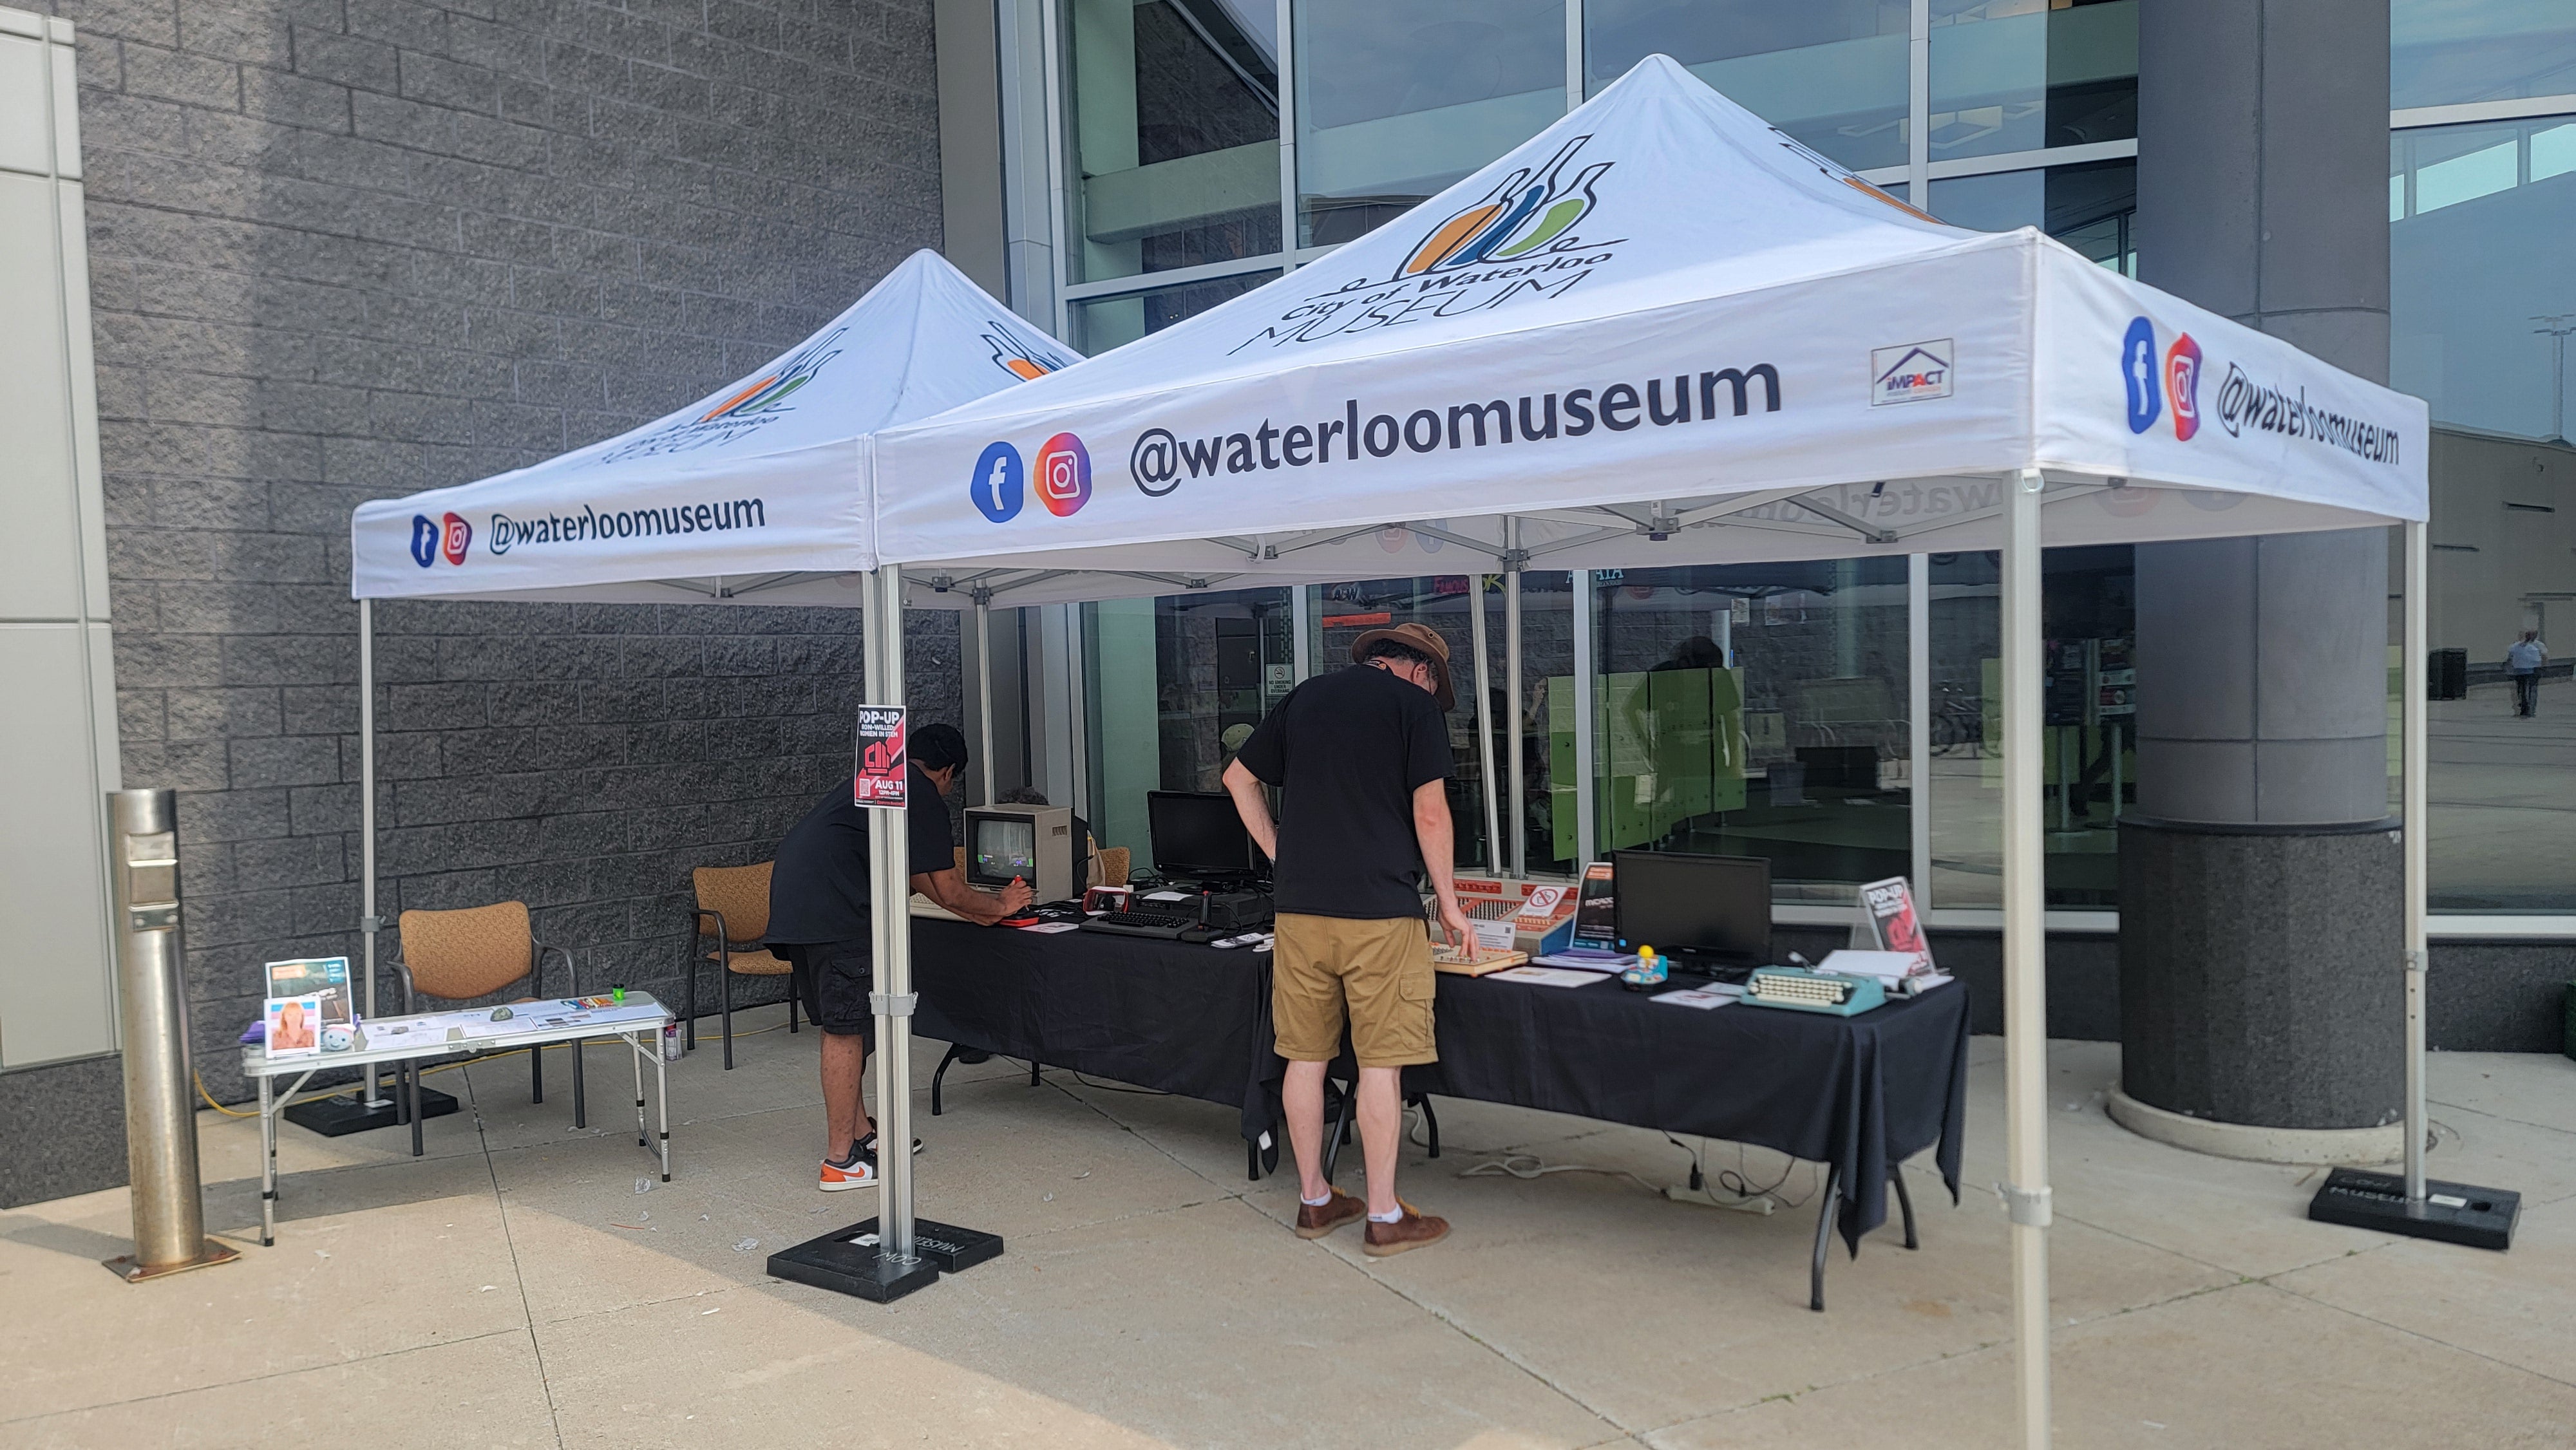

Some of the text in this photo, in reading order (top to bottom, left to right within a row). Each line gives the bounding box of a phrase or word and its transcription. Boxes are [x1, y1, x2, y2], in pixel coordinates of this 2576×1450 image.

[1226, 269, 1595, 356] MUSEUM
[1281, 253, 1613, 321] City of Waterloo
[1130, 362, 1781, 498] @waterloomuseum
[2217, 361, 2400, 466] @waterloomuseum
[490, 496, 766, 555] @waterloomuseum
[860, 711, 900, 724] POP-UP
[875, 780, 903, 791] AUG 11
